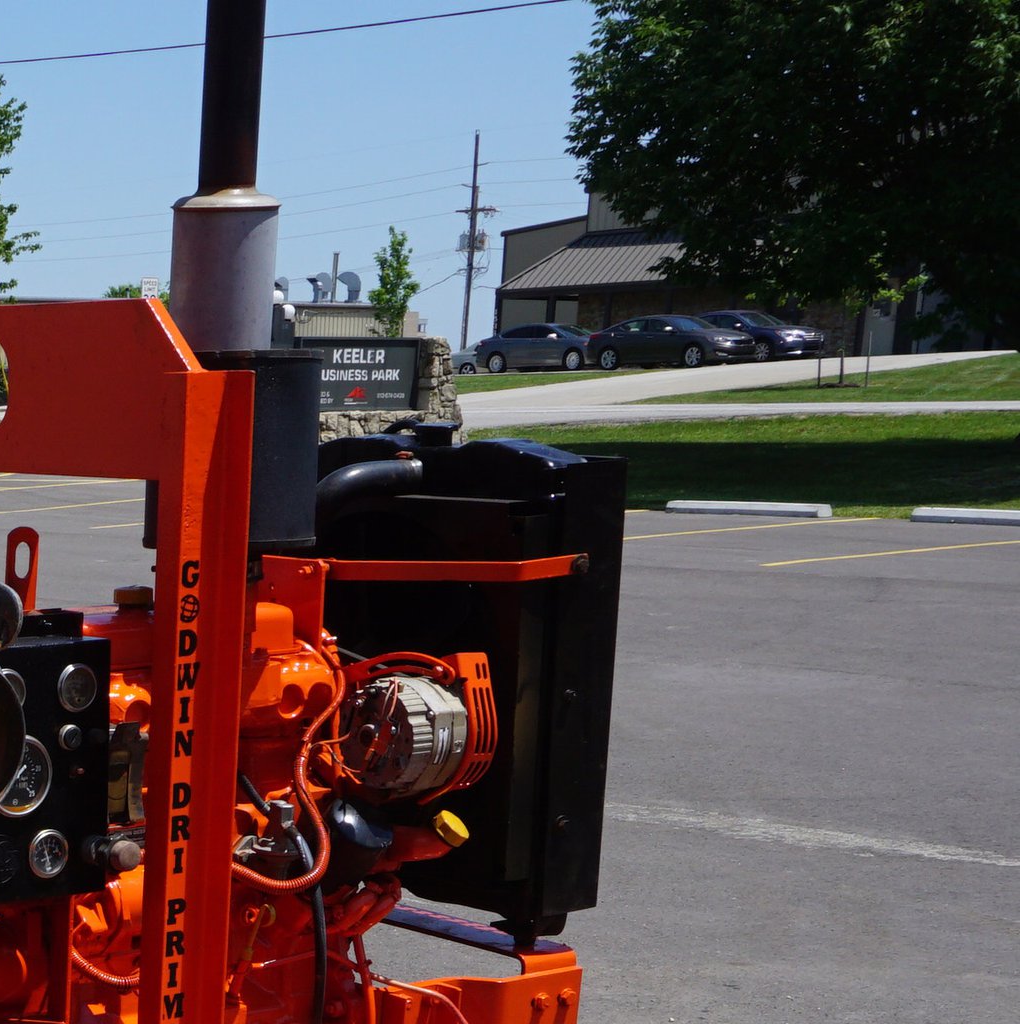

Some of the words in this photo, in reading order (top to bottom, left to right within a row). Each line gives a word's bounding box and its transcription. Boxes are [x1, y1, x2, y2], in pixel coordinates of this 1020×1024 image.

[333, 349, 385, 364] KEELER
[321, 369, 368, 381] USINESS
[371, 369, 400, 381] PARK
[171, 782, 191, 875] DRI
